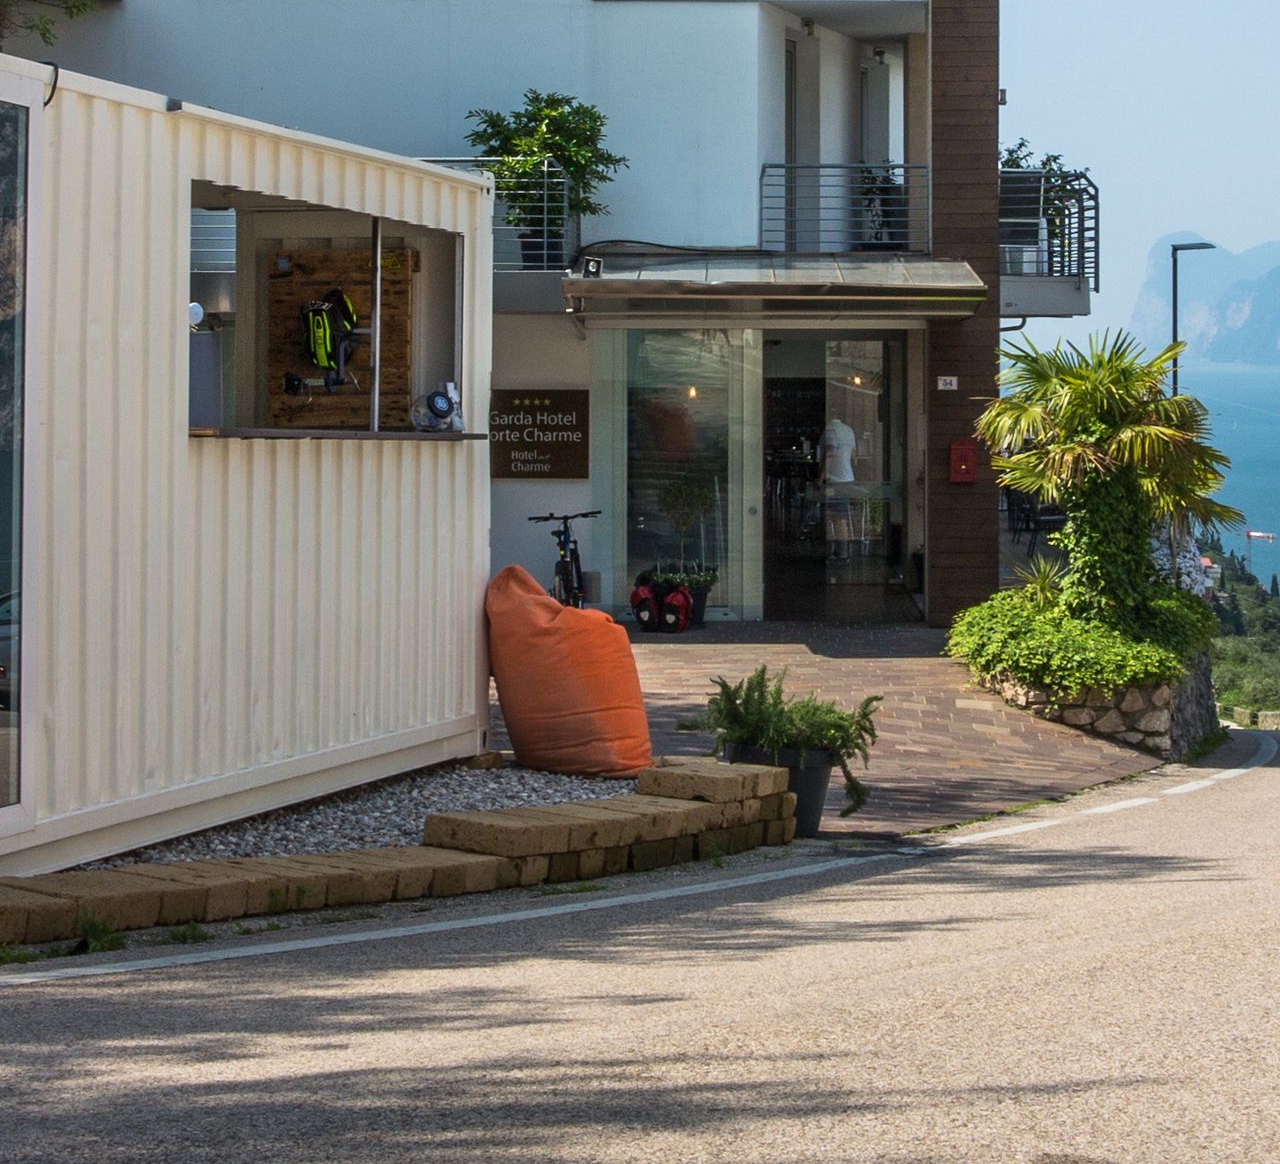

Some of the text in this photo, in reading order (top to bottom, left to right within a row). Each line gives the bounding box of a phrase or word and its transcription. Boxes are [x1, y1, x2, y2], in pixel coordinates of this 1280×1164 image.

[490, 411, 577, 426] Garda Hotel
[489, 427, 583, 442] orte Charme
[511, 450, 537, 460] Hotel
[511, 461, 551, 473] Charme
